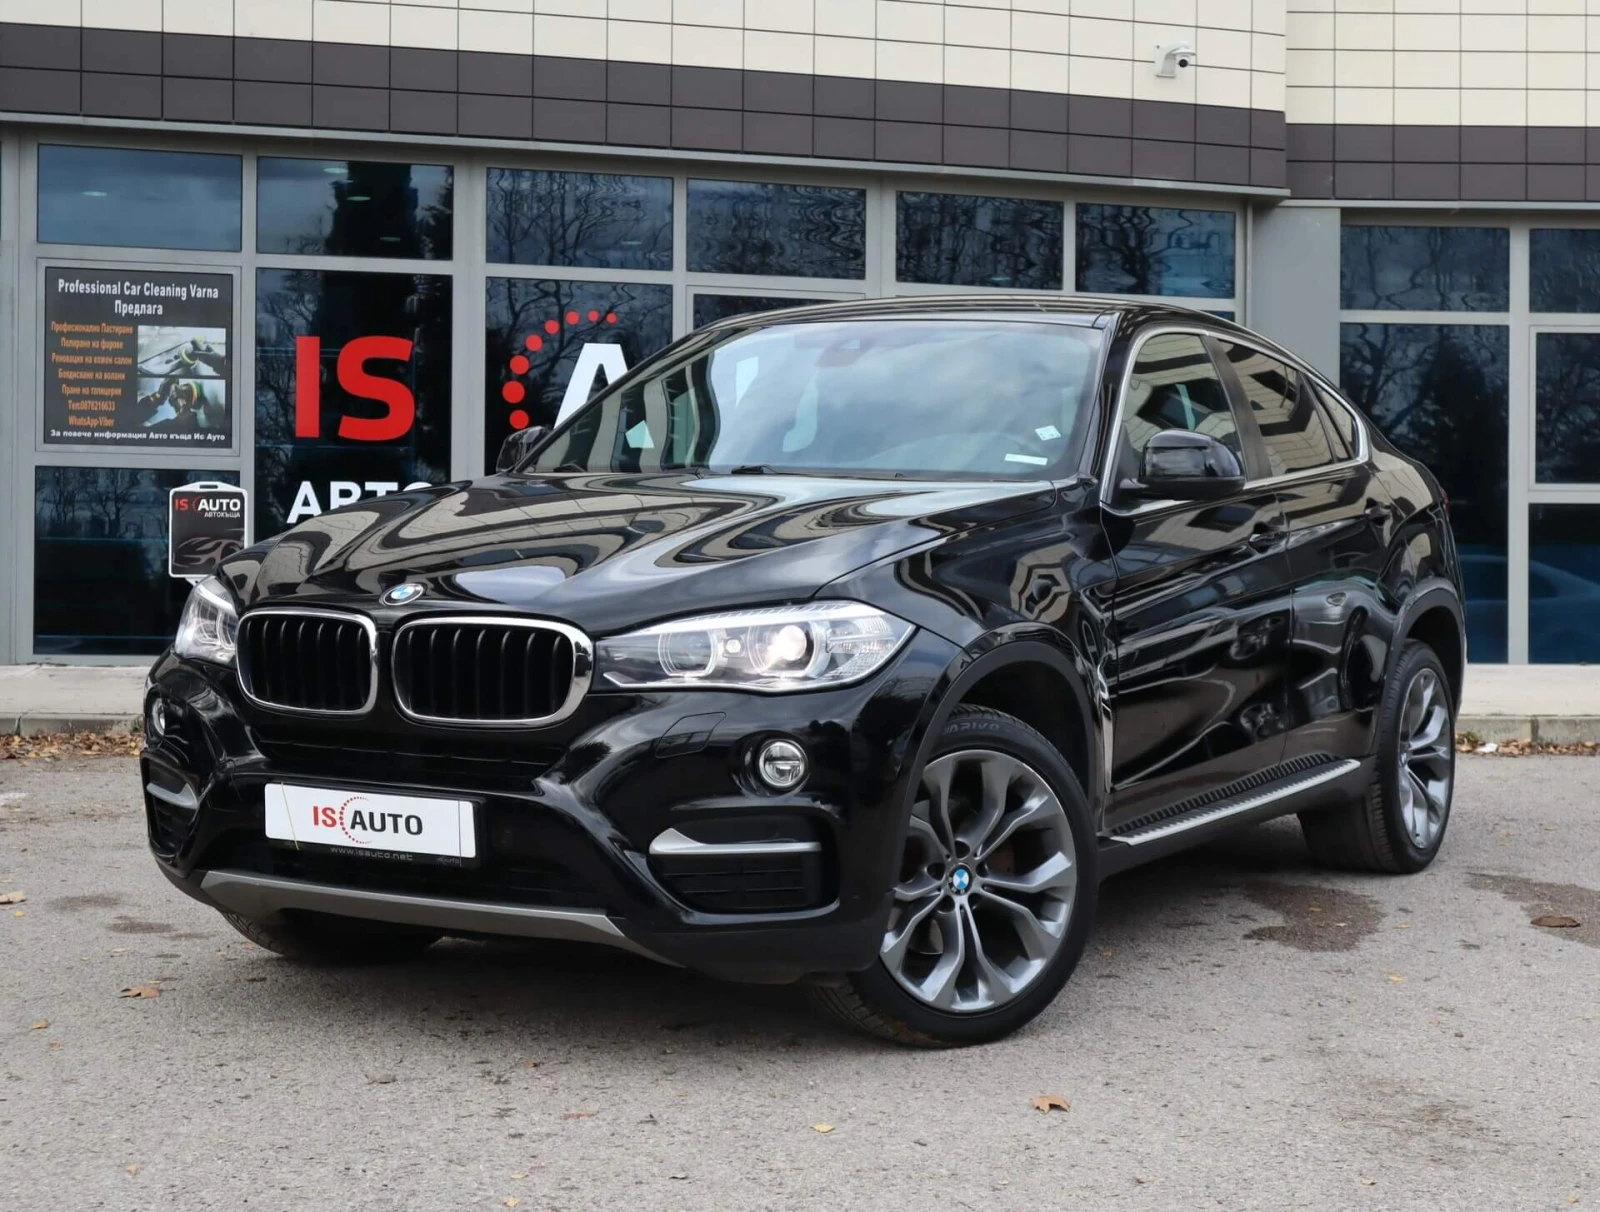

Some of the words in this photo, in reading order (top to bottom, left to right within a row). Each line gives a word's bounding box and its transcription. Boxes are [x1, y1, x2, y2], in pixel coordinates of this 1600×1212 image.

[58, 278, 121, 295] Professional
[124, 281, 141, 296] Car
[144, 282, 187, 300] Cleaning
[190, 283, 219, 299] Varna
[115, 299, 163, 317] Предлага
[295, 335, 416, 442] IS
[50, 428, 61, 437] За
[62, 430, 92, 438] повече
[94, 430, 147, 440] информация
[149, 431, 168, 440] Авто
[169, 433, 192, 441] къща
[206, 433, 226, 442] Ауто
[175, 498, 189, 511] IS
[197, 498, 241, 512] AUTO
[204, 511, 241, 519] АВТОКЪЩА
[312, 805, 338, 828] IS
[350, 809, 423, 836] AUTO
